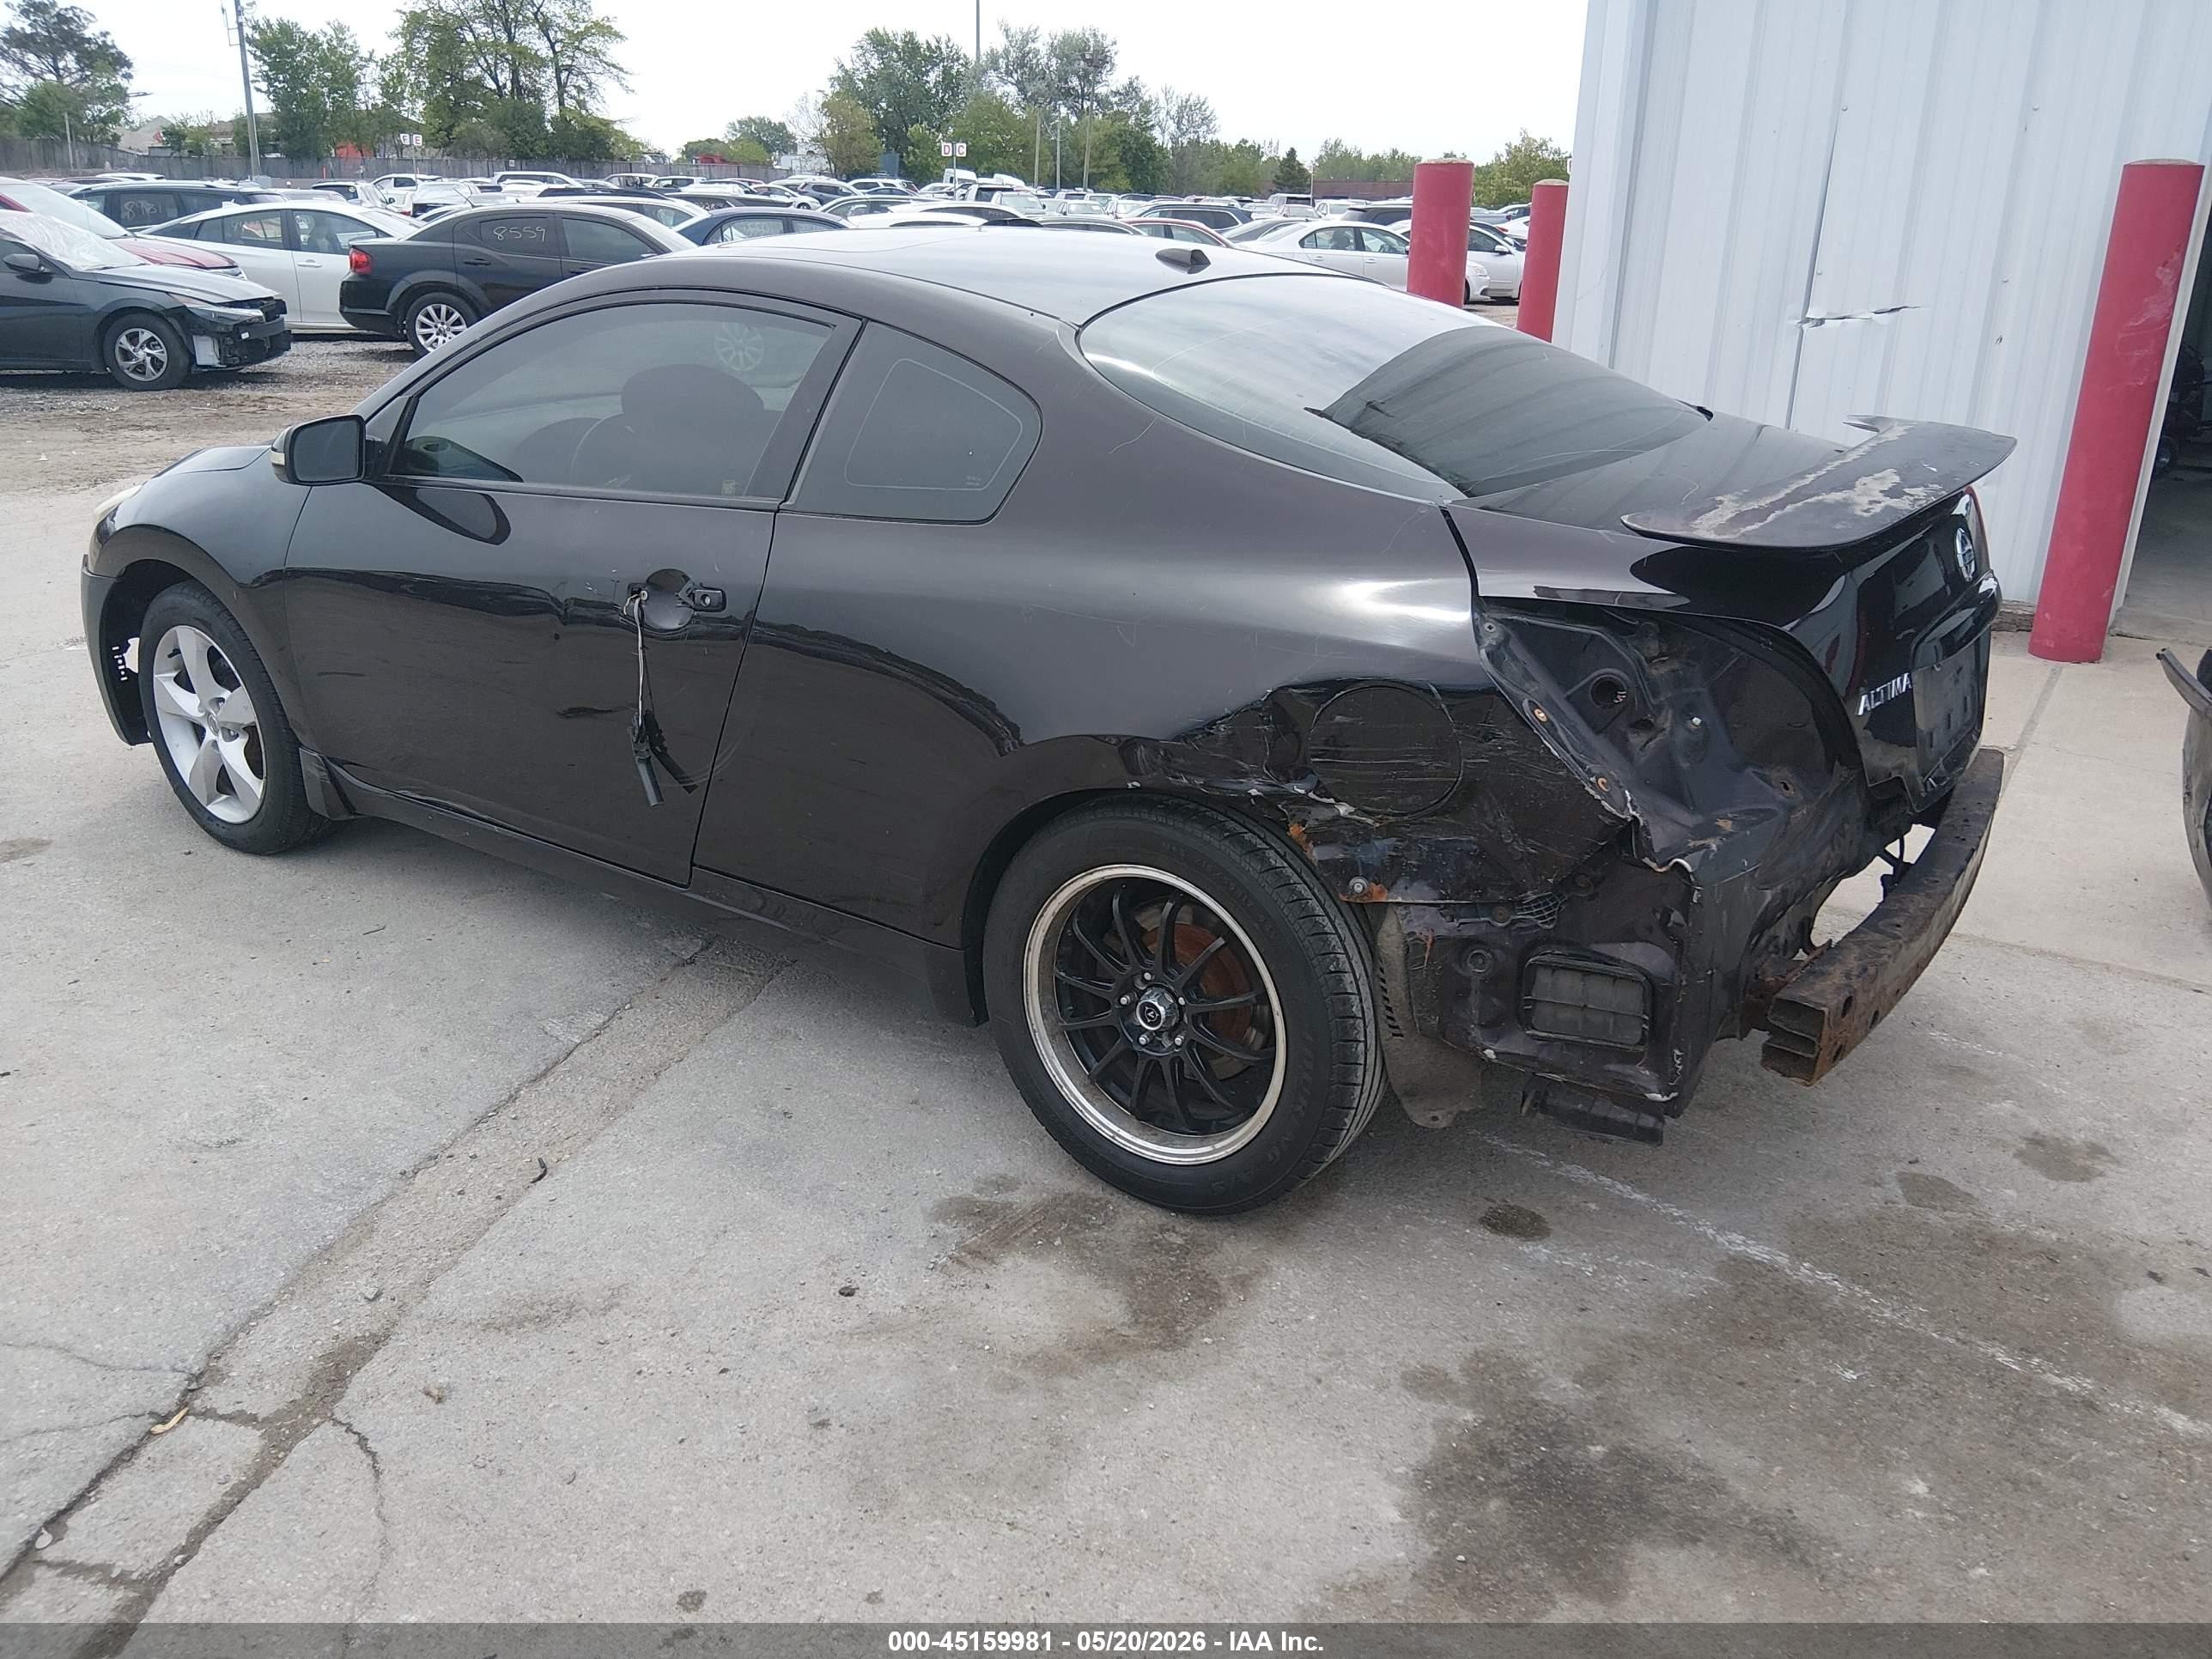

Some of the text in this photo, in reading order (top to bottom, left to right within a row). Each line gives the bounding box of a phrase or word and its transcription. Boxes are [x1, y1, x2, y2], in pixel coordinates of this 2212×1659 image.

[943, 144, 951, 155] D
[957, 144, 965, 155] C
[493, 226, 546, 242] 8559
[1856, 672, 1912, 715] ALTIMA
